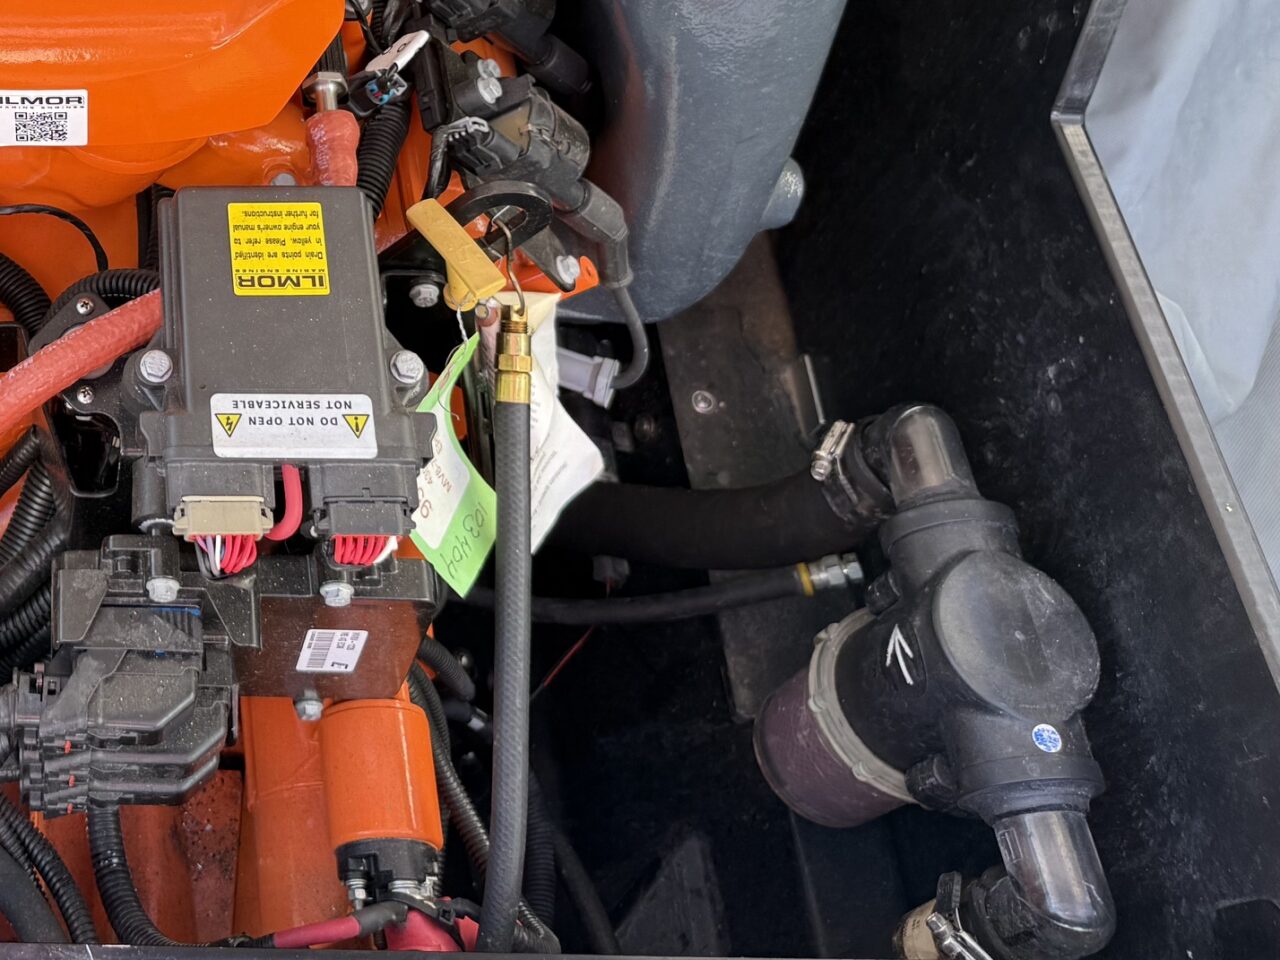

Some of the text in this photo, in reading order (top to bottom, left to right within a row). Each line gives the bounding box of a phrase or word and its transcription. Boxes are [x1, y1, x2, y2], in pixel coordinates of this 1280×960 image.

[242, 210, 319, 218] for further instructions.
[233, 222, 321, 232] your engine owner's manual
[245, 238, 261, 246] refer
[265, 238, 286, 246] Please
[290, 236, 312, 246] yellow.
[234, 251, 265, 260] identified
[281, 250, 302, 260] points
[305, 251, 323, 260] Drain
[238, 276, 324, 287] ILMOR
[231, 400, 352, 410] NOT SERVICEABLE
[248, 416, 338, 426] DO NOT OPEN
